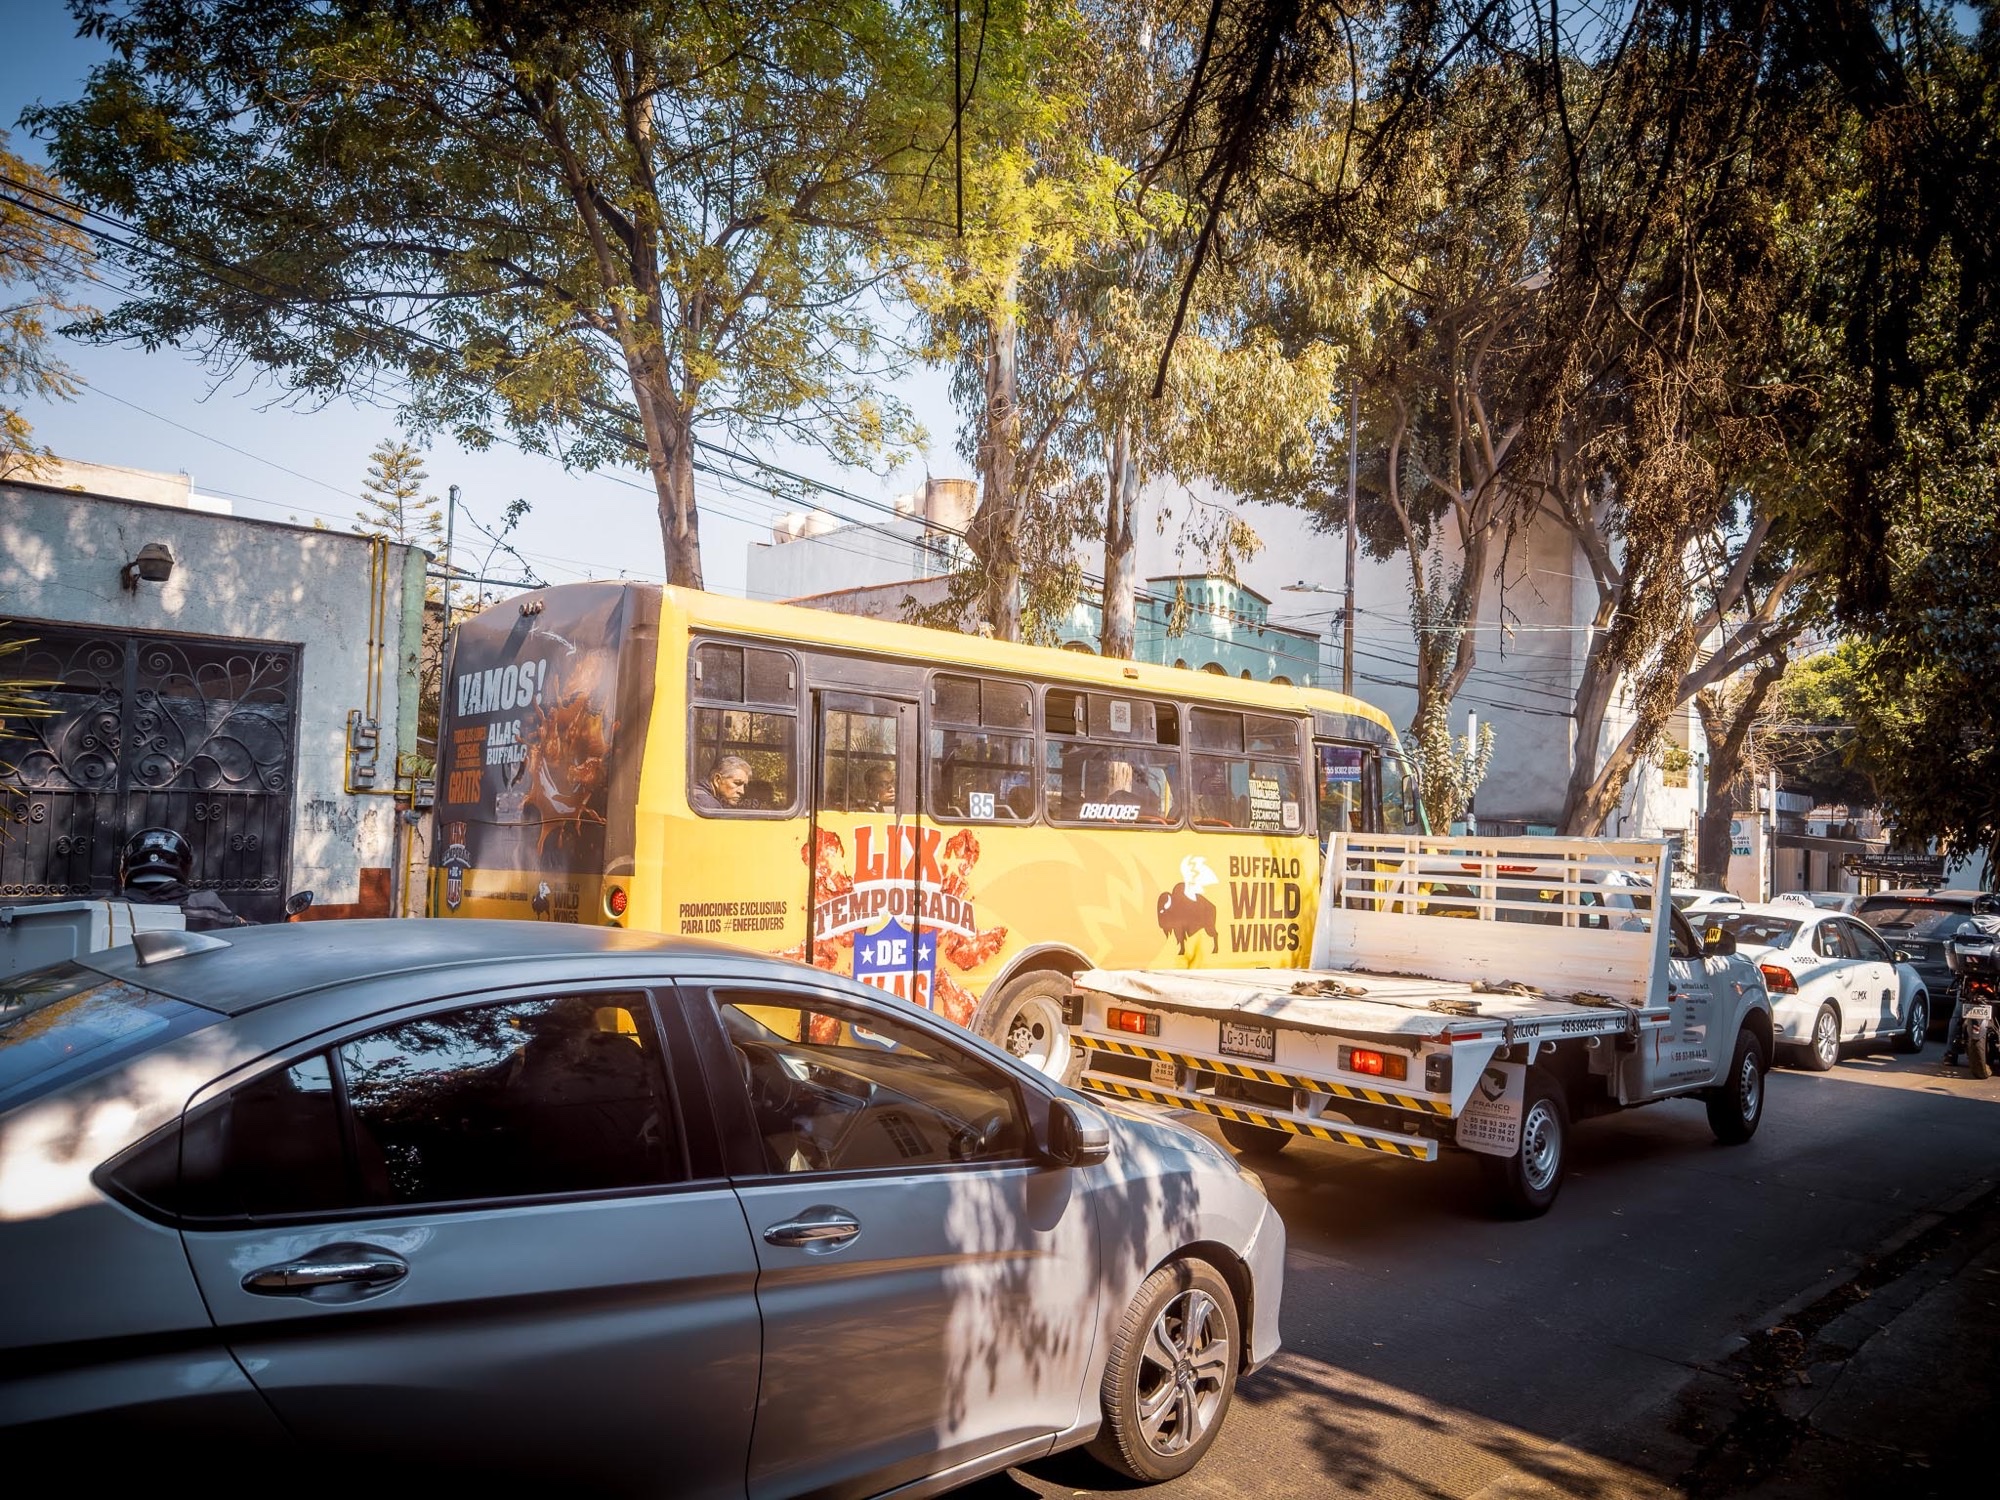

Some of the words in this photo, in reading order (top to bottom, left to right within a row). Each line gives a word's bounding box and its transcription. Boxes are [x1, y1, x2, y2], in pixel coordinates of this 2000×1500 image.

[458, 658, 547, 717] VAMOS!
[487, 719, 521, 747] ALAS
[486, 744, 528, 765] BUFFALO
[971, 794, 993, 817] 85
[1079, 803, 1141, 820] 0800085
[854, 825, 942, 884] LIX
[1731, 847, 1750, 855] NTA
[1229, 856, 1300, 879] BUFFALO
[680, 903, 738, 918] PROMOCIONES
[740, 901, 787, 916] EXCLUSIVAS
[815, 888, 976, 936] TEMPORADA
[1229, 882, 1300, 919] WILD
[681, 919, 703, 934] PARA
[705, 919, 721, 933] LOS
[723, 916, 784, 932] #ENEFELOVERS
[1230, 923, 1300, 952] WINGS
[876, 939, 906, 966] DE
[1222, 1030, 1272, 1050] LG-31-600
[1473, 1101, 1510, 1111] FRANCO
